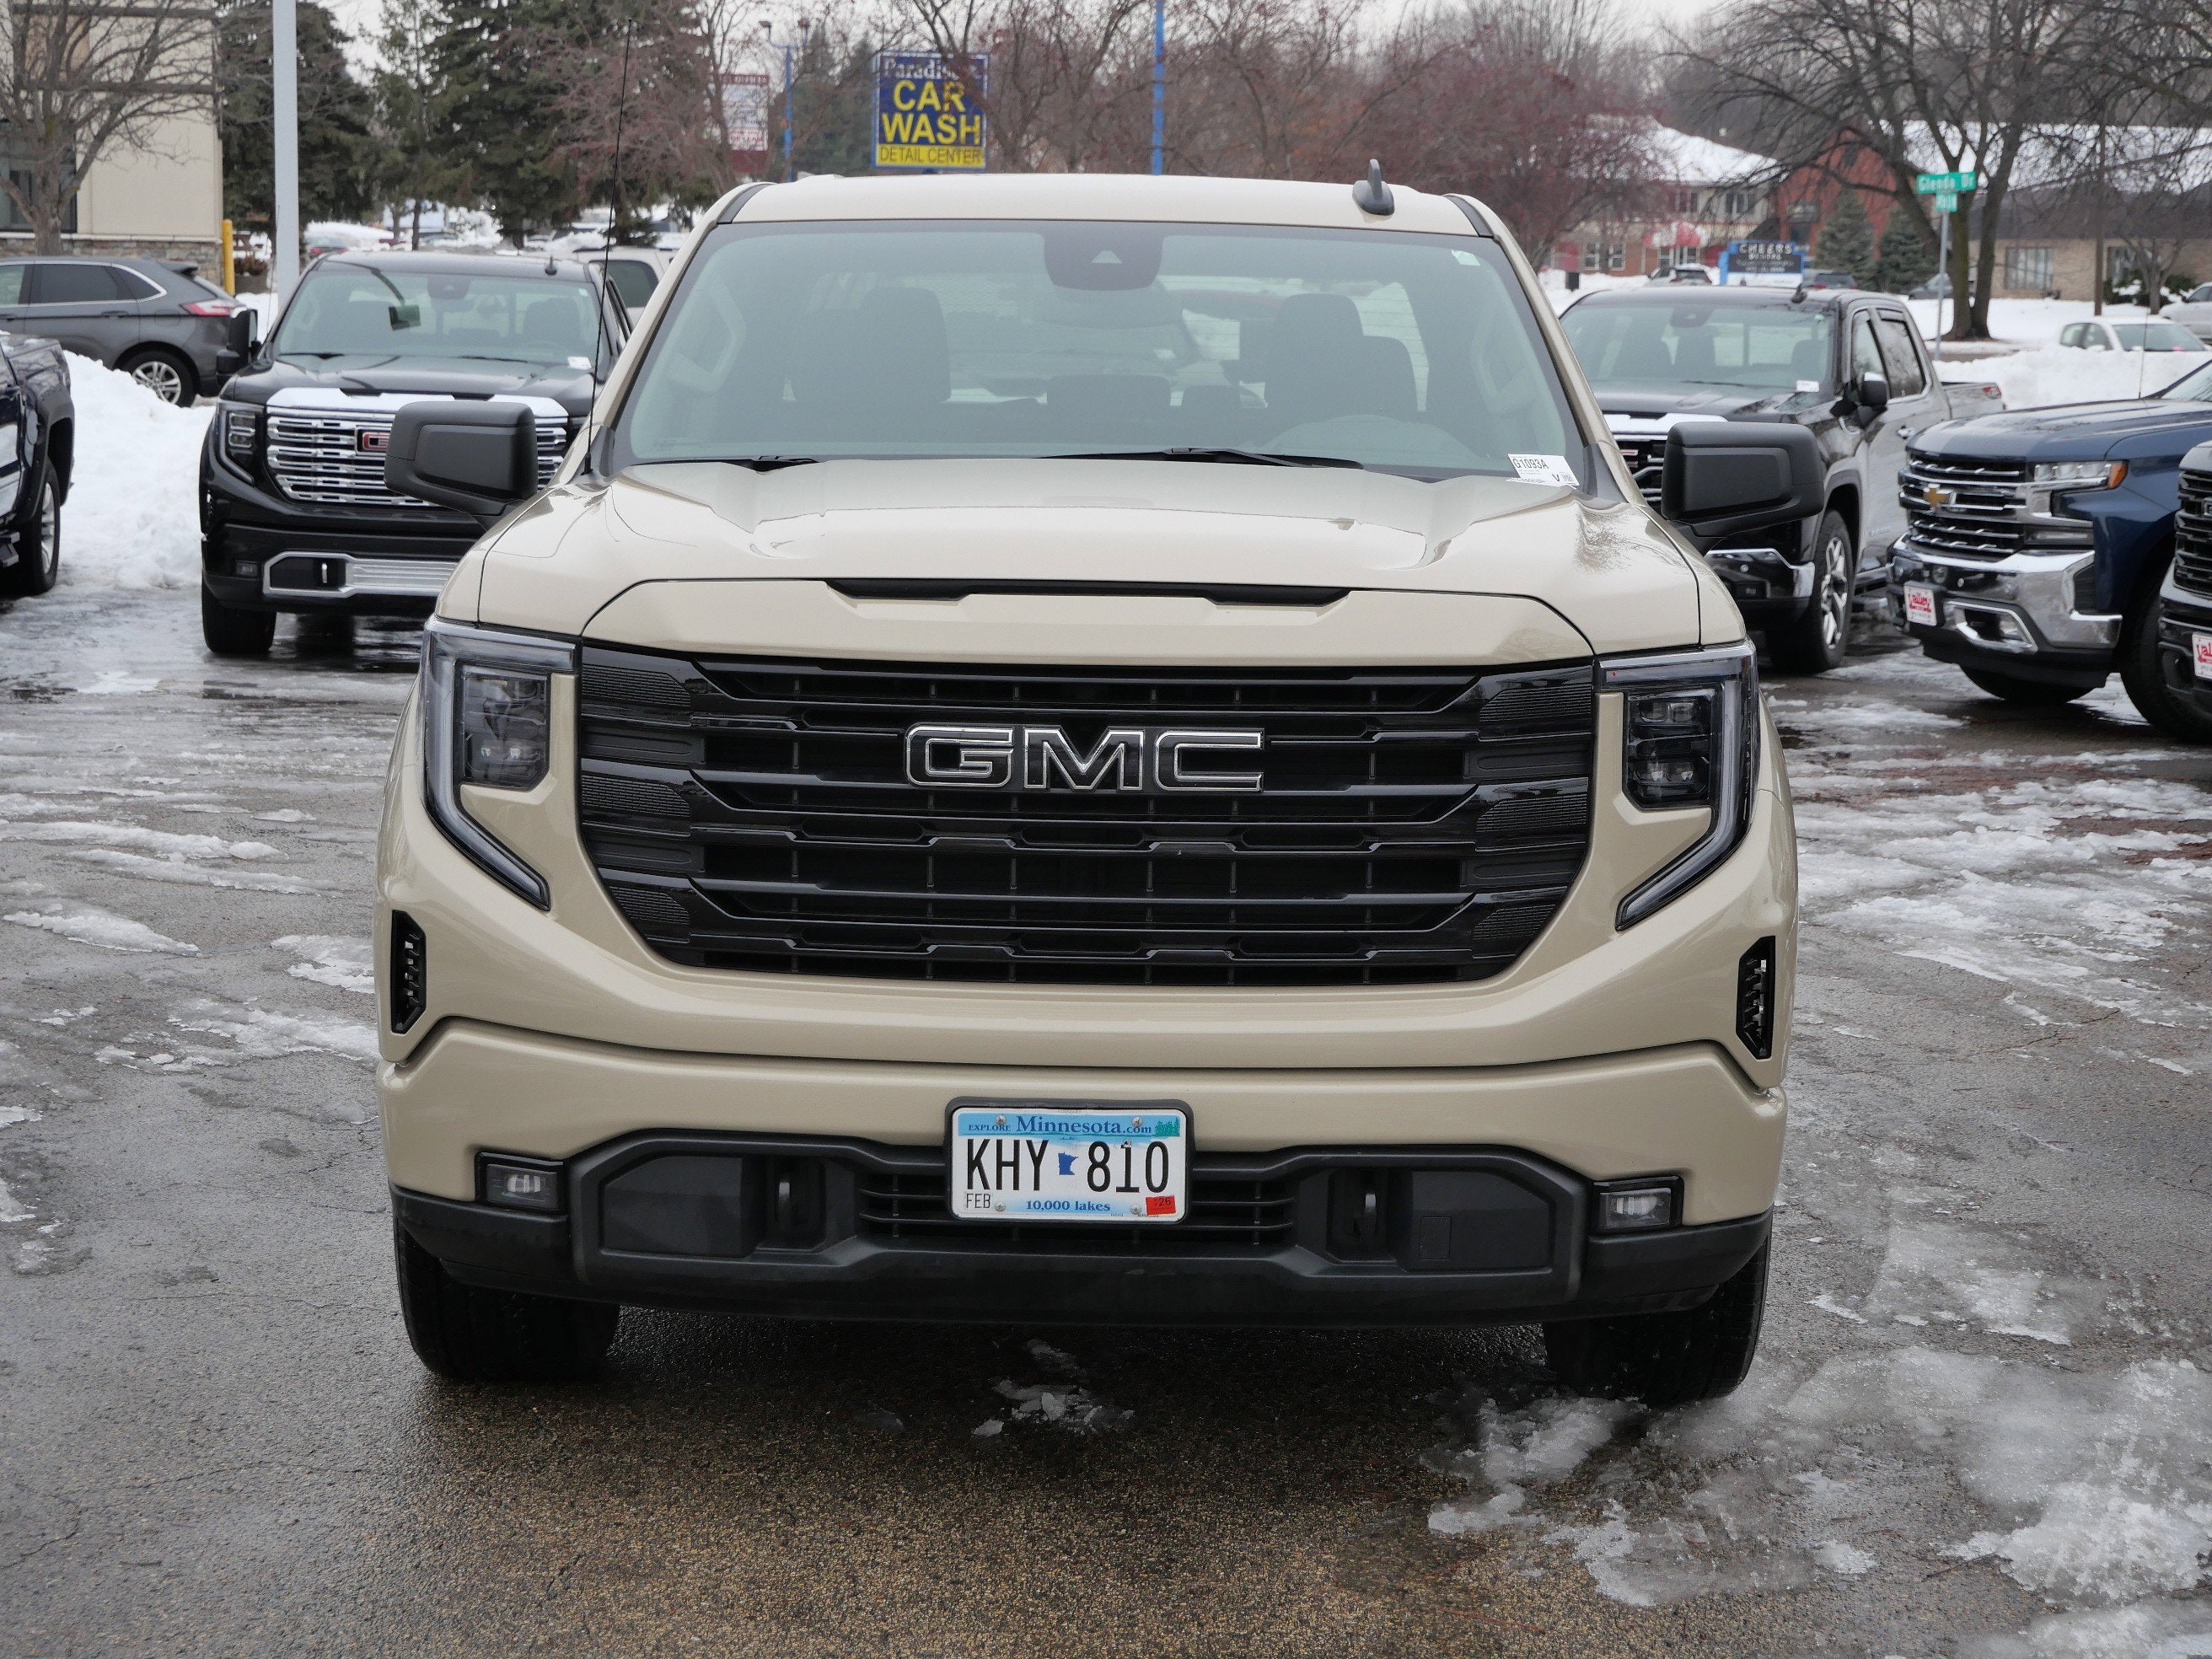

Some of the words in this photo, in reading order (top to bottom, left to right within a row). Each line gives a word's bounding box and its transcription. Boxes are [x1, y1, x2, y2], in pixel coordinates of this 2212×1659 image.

[894, 79, 966, 112] CAR
[881, 113, 981, 145] WASH
[880, 147, 923, 163] DETAIL
[928, 148, 983, 164] CENTER
[1961, 173, 1974, 188] Dr
[1738, 243, 1793, 255] CHEERS
[1512, 458, 1549, 470] G1093A
[905, 726, 1264, 792] GMC
[969, 1124, 1012, 1132] EXPLORE
[1016, 1115, 1152, 1135] Minnesota.com
[967, 1138, 1050, 1191] KHY
[1087, 1141, 1169, 1194] 810
[966, 1193, 991, 1209] FEB
[1025, 1200, 1071, 1211] 10,000
[1074, 1200, 1111, 1211] lakes
[1158, 1197, 1171, 1206] 26
